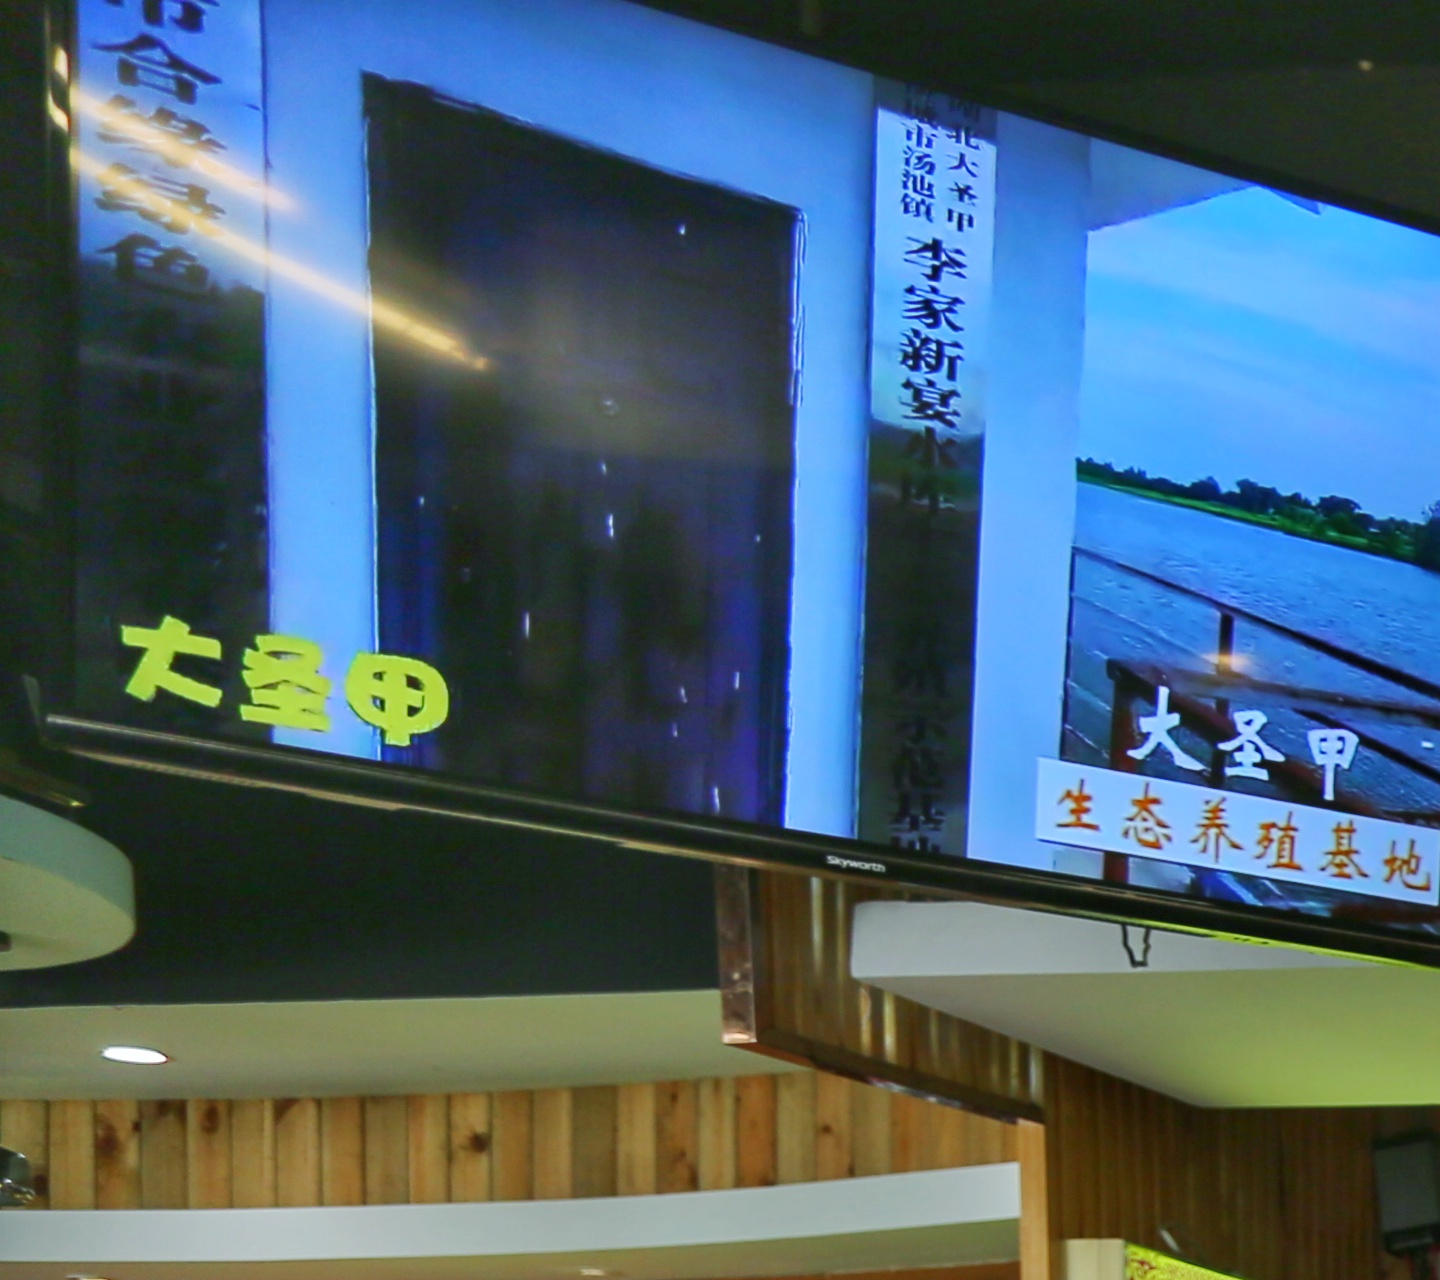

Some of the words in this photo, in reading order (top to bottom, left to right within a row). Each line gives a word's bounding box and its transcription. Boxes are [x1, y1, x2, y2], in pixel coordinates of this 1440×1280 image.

[120, 616, 449, 745] 大圣甲
[1126, 686, 1360, 800] 大圣甲
[826, 854, 887, 875] Skyworth
[1056, 787, 1433, 892] 生态养殖基地
